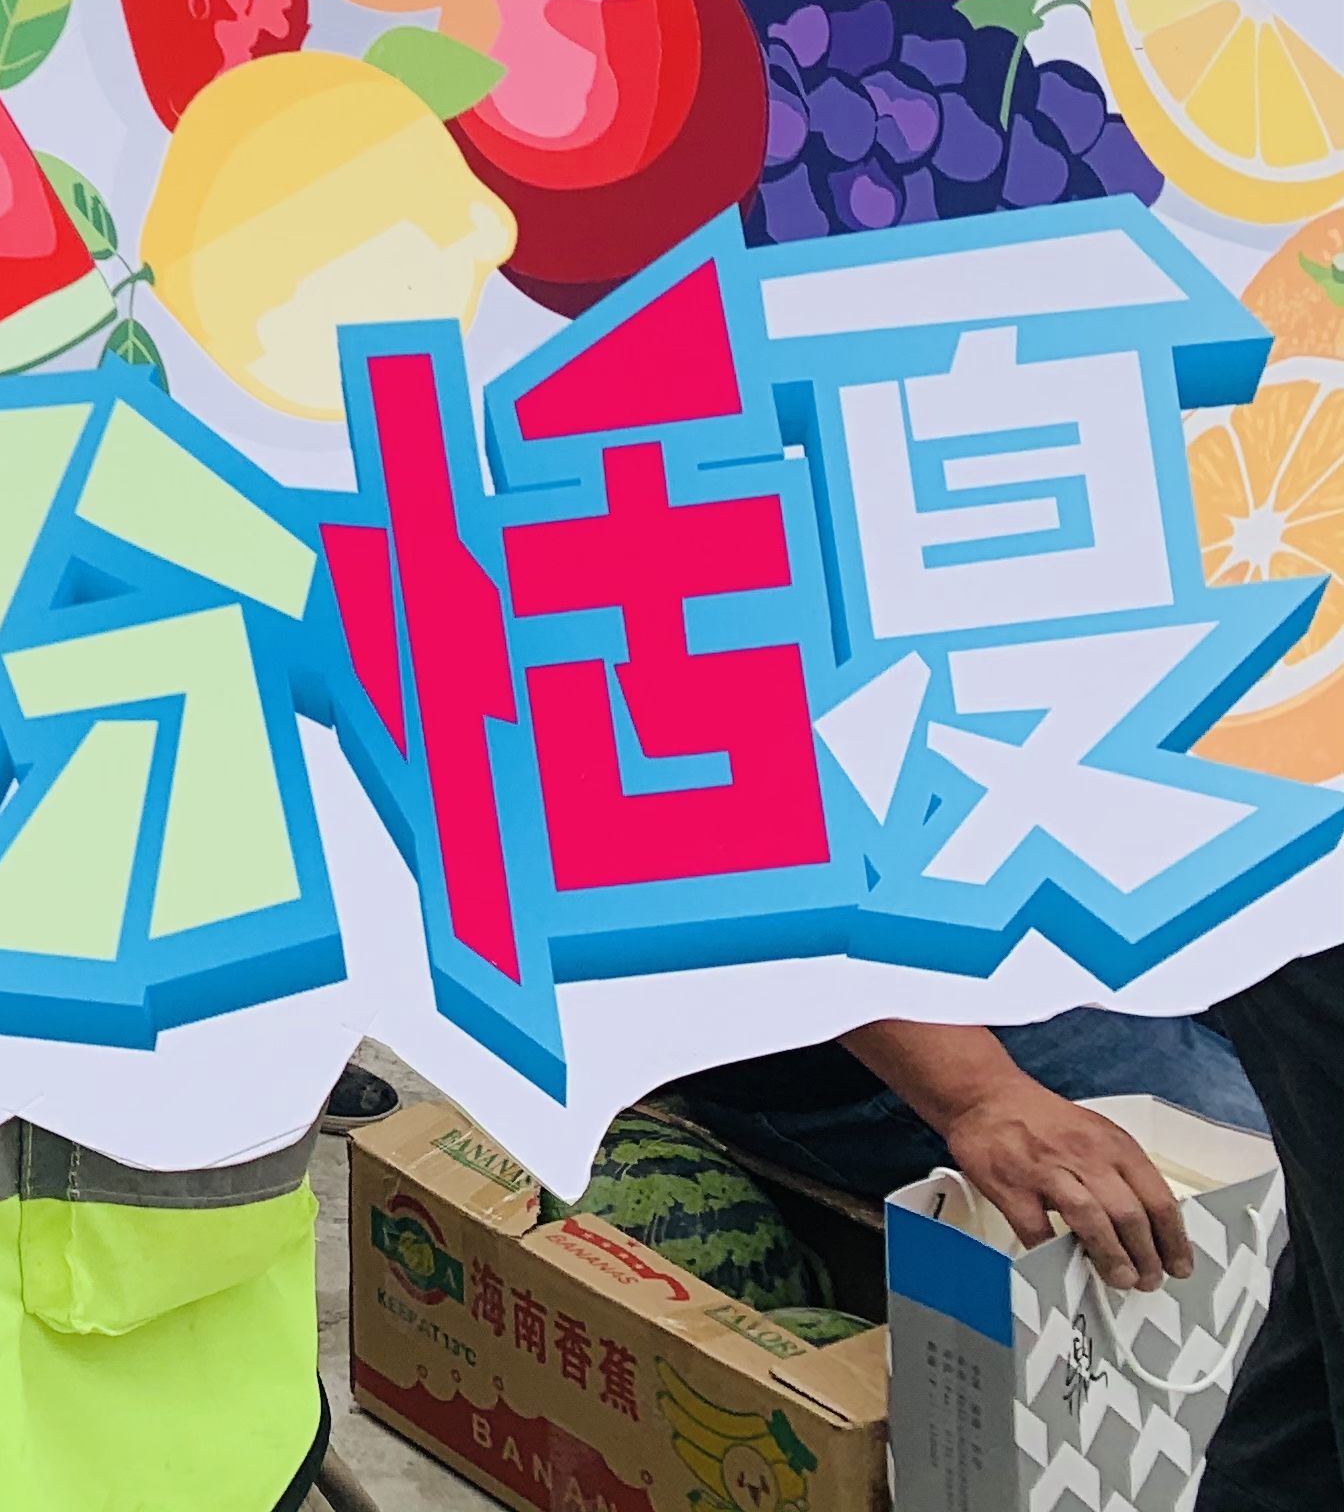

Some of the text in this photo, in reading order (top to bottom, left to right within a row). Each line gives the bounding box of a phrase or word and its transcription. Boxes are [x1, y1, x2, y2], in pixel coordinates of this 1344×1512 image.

[544, 1234, 639, 1285] BANANAS
[470, 1256, 639, 1422] 海南香蕉
